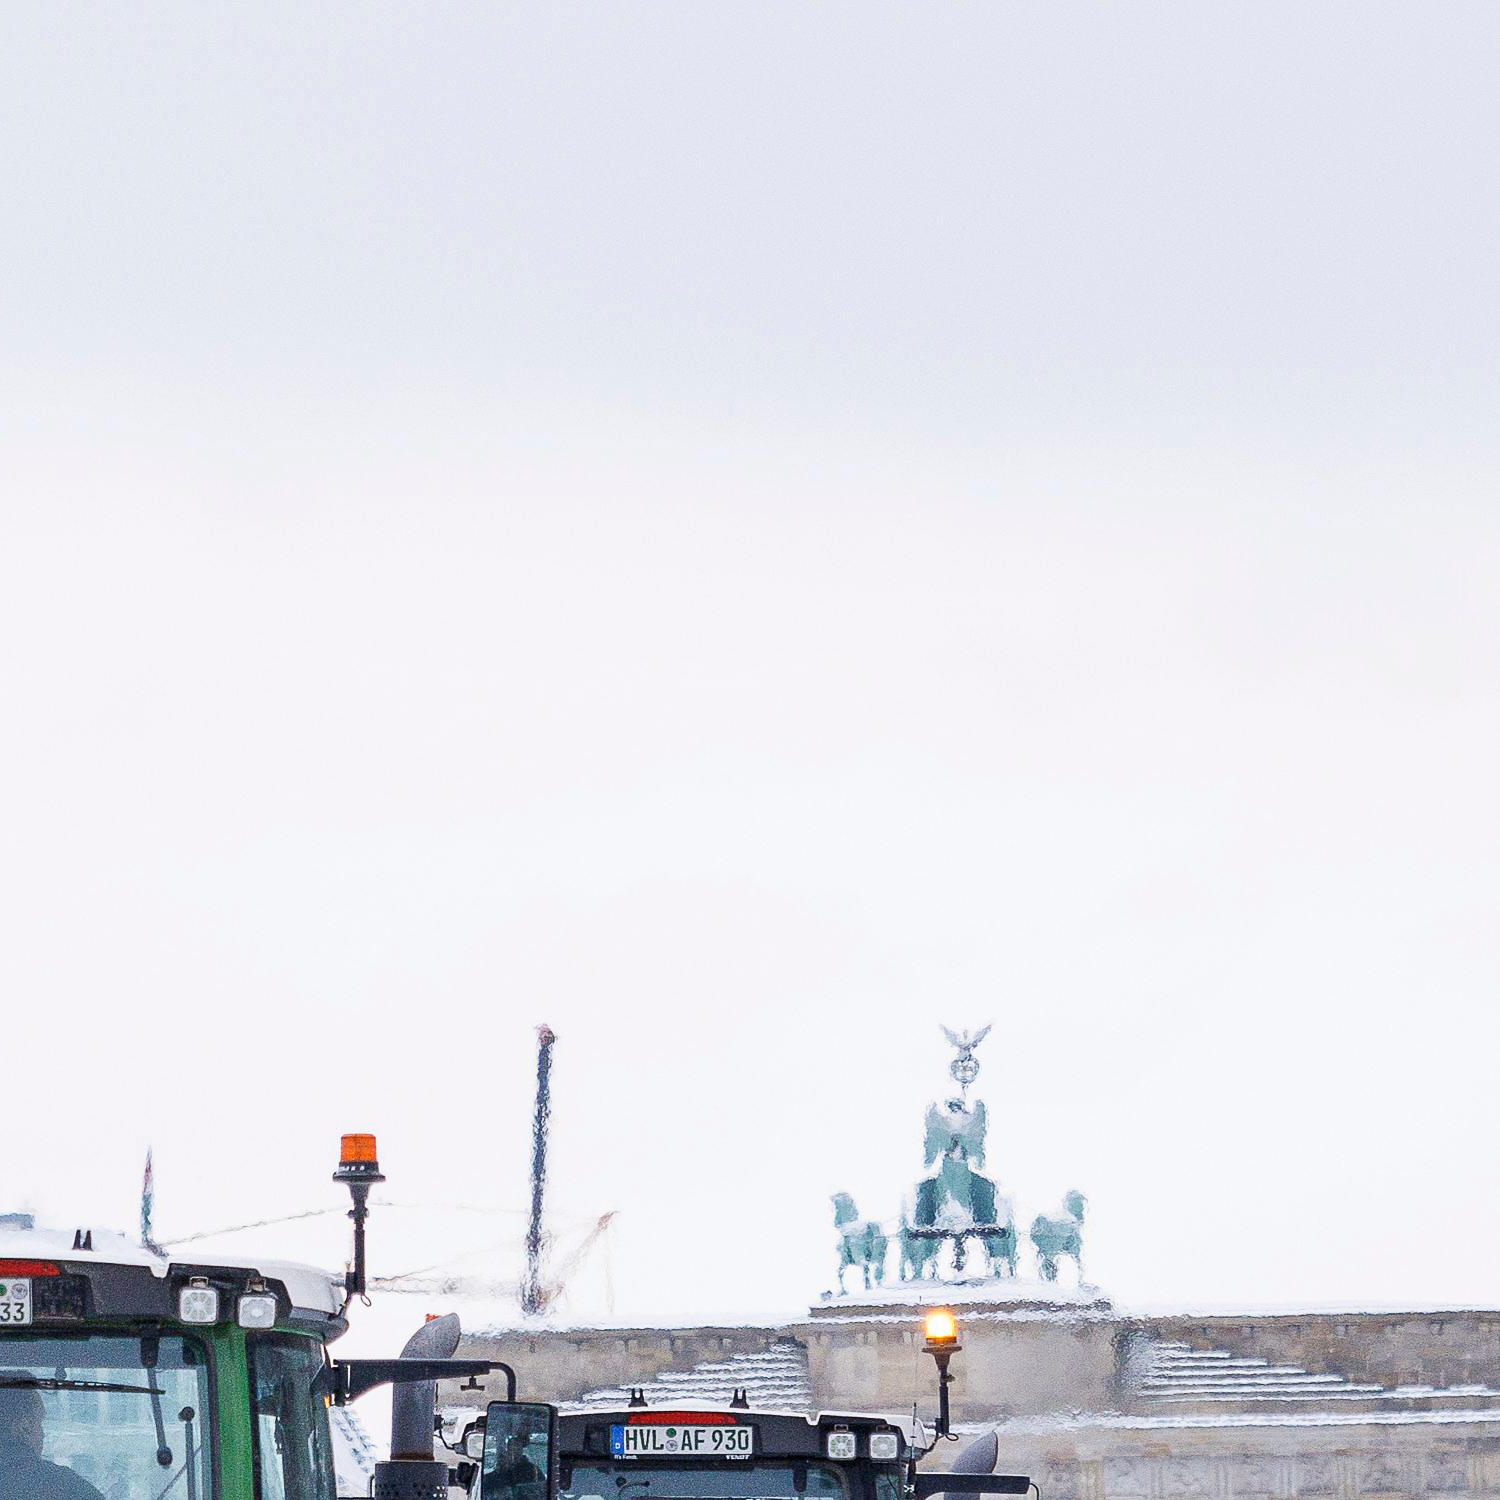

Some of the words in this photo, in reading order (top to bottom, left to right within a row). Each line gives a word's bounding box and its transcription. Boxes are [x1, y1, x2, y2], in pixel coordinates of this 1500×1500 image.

[625, 1429, 665, 1451] HVL
[681, 1429, 705, 1451] AF
[711, 1429, 750, 1451] 930
